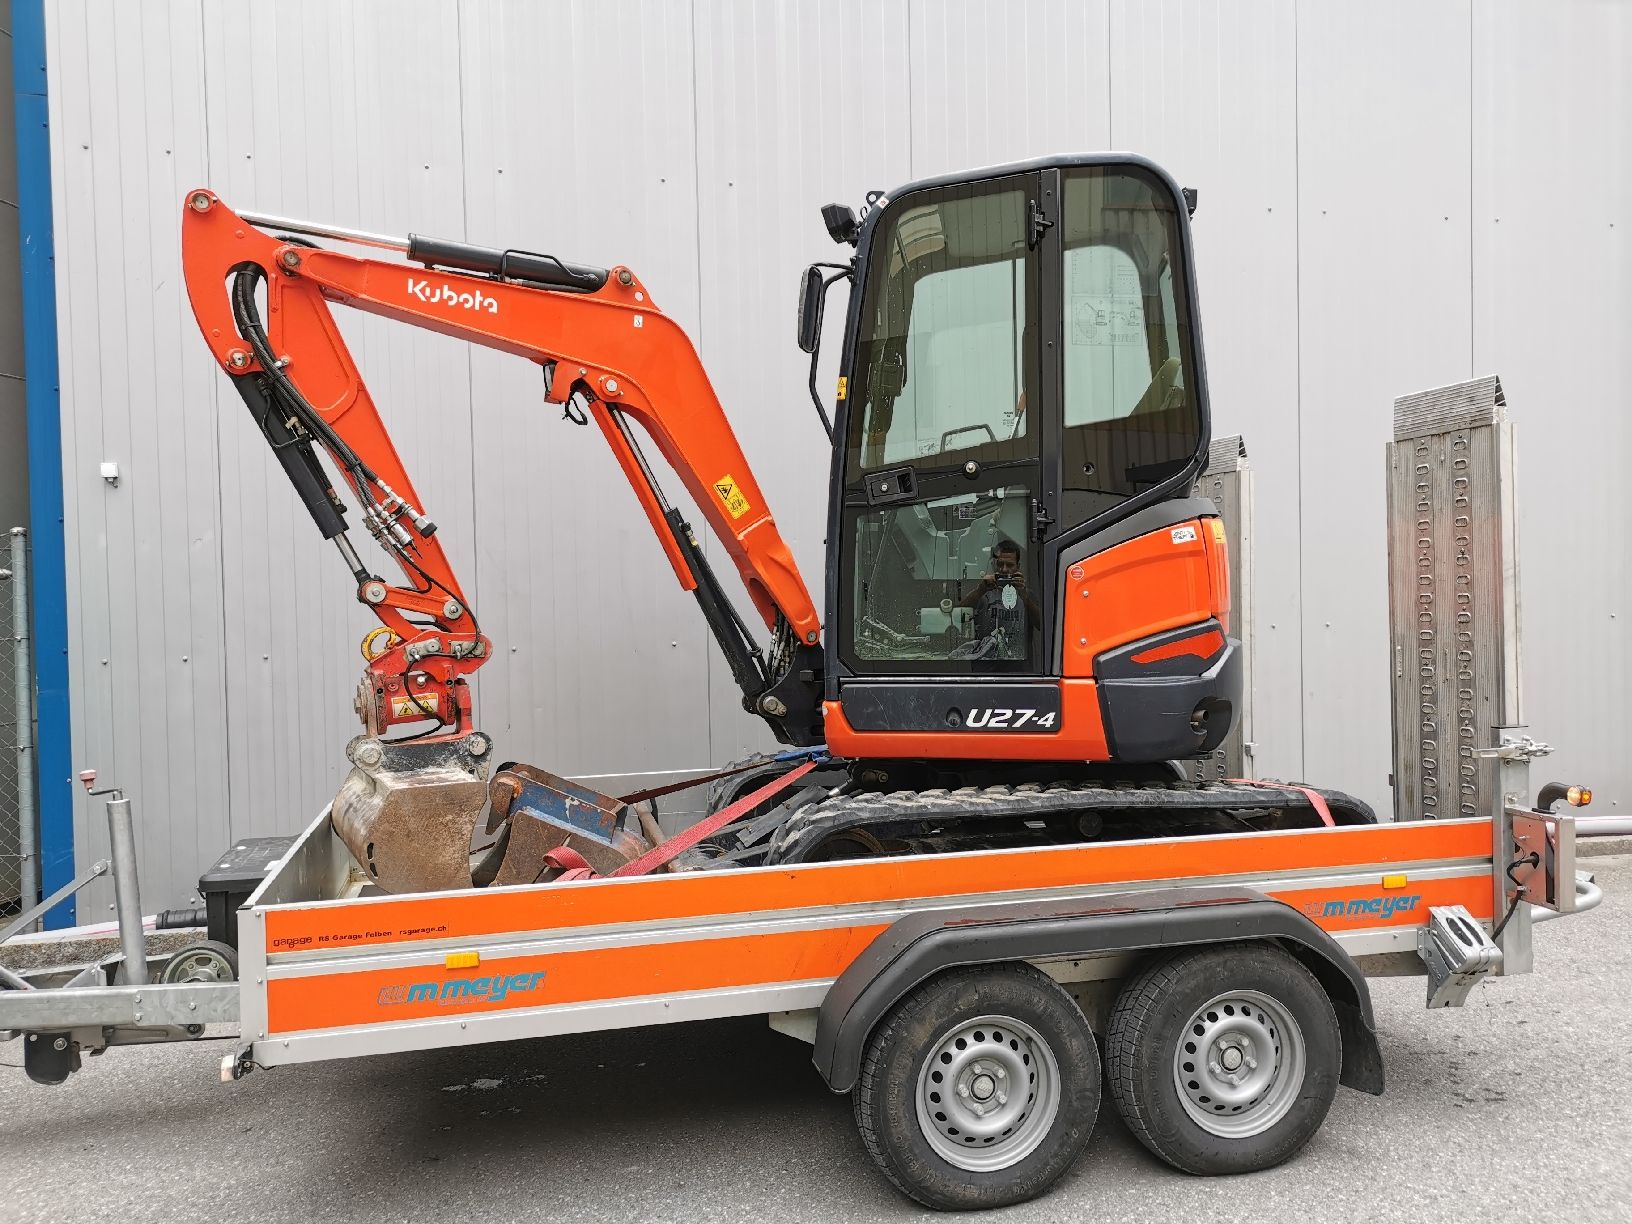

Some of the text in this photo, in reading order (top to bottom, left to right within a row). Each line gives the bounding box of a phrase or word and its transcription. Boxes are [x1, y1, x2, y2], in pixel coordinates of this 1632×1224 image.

[407, 278, 498, 314] Kubota
[966, 708, 1056, 728] U27-4
[273, 936, 312, 948] garage
[332, 933, 363, 942] Garage
